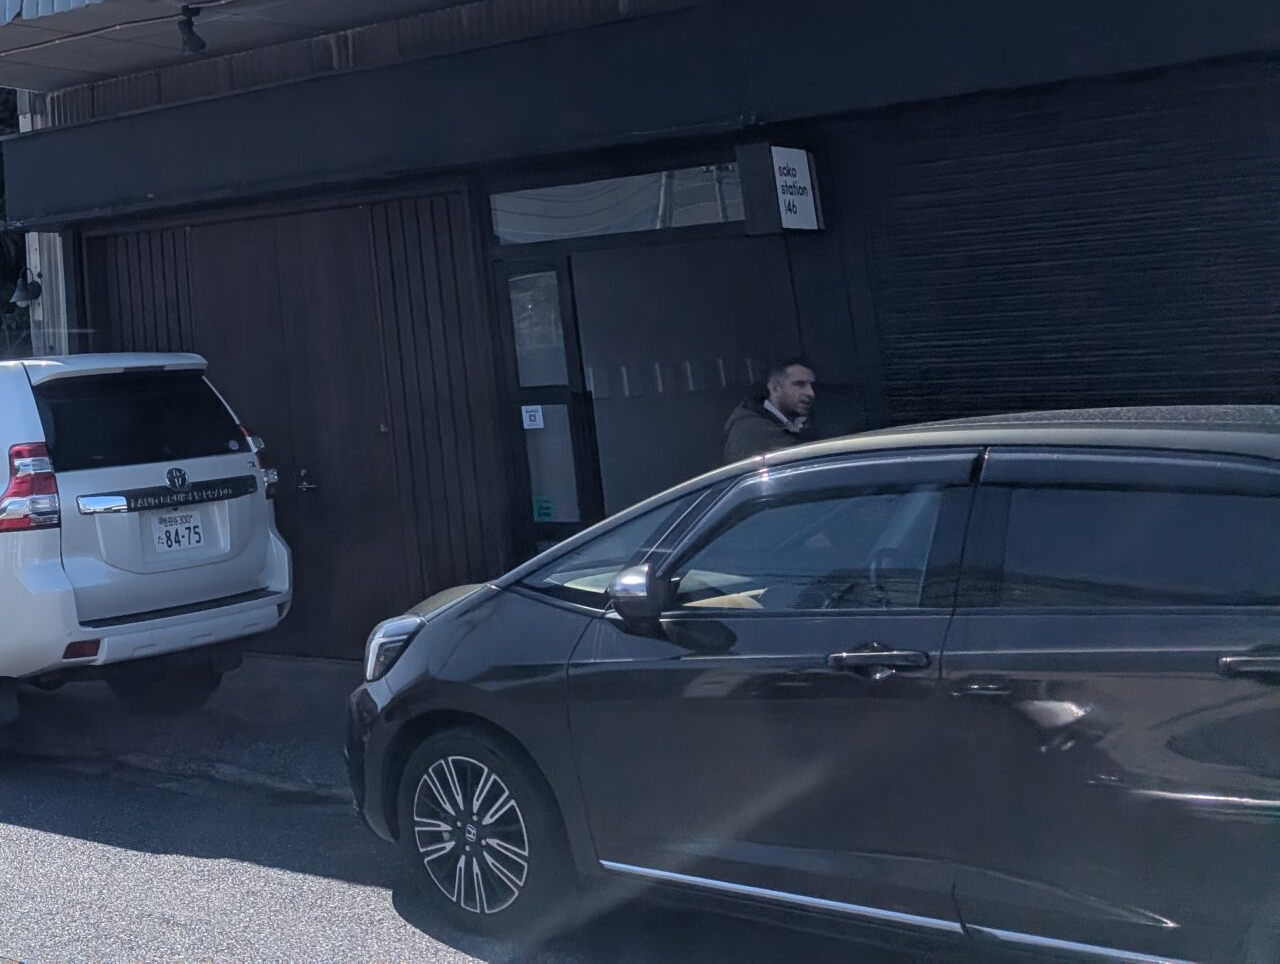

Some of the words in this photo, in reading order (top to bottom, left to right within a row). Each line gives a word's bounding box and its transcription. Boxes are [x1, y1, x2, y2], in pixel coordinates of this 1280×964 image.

[778, 161, 797, 178] soko
[780, 179, 808, 197] station
[783, 198, 798, 215] 146
